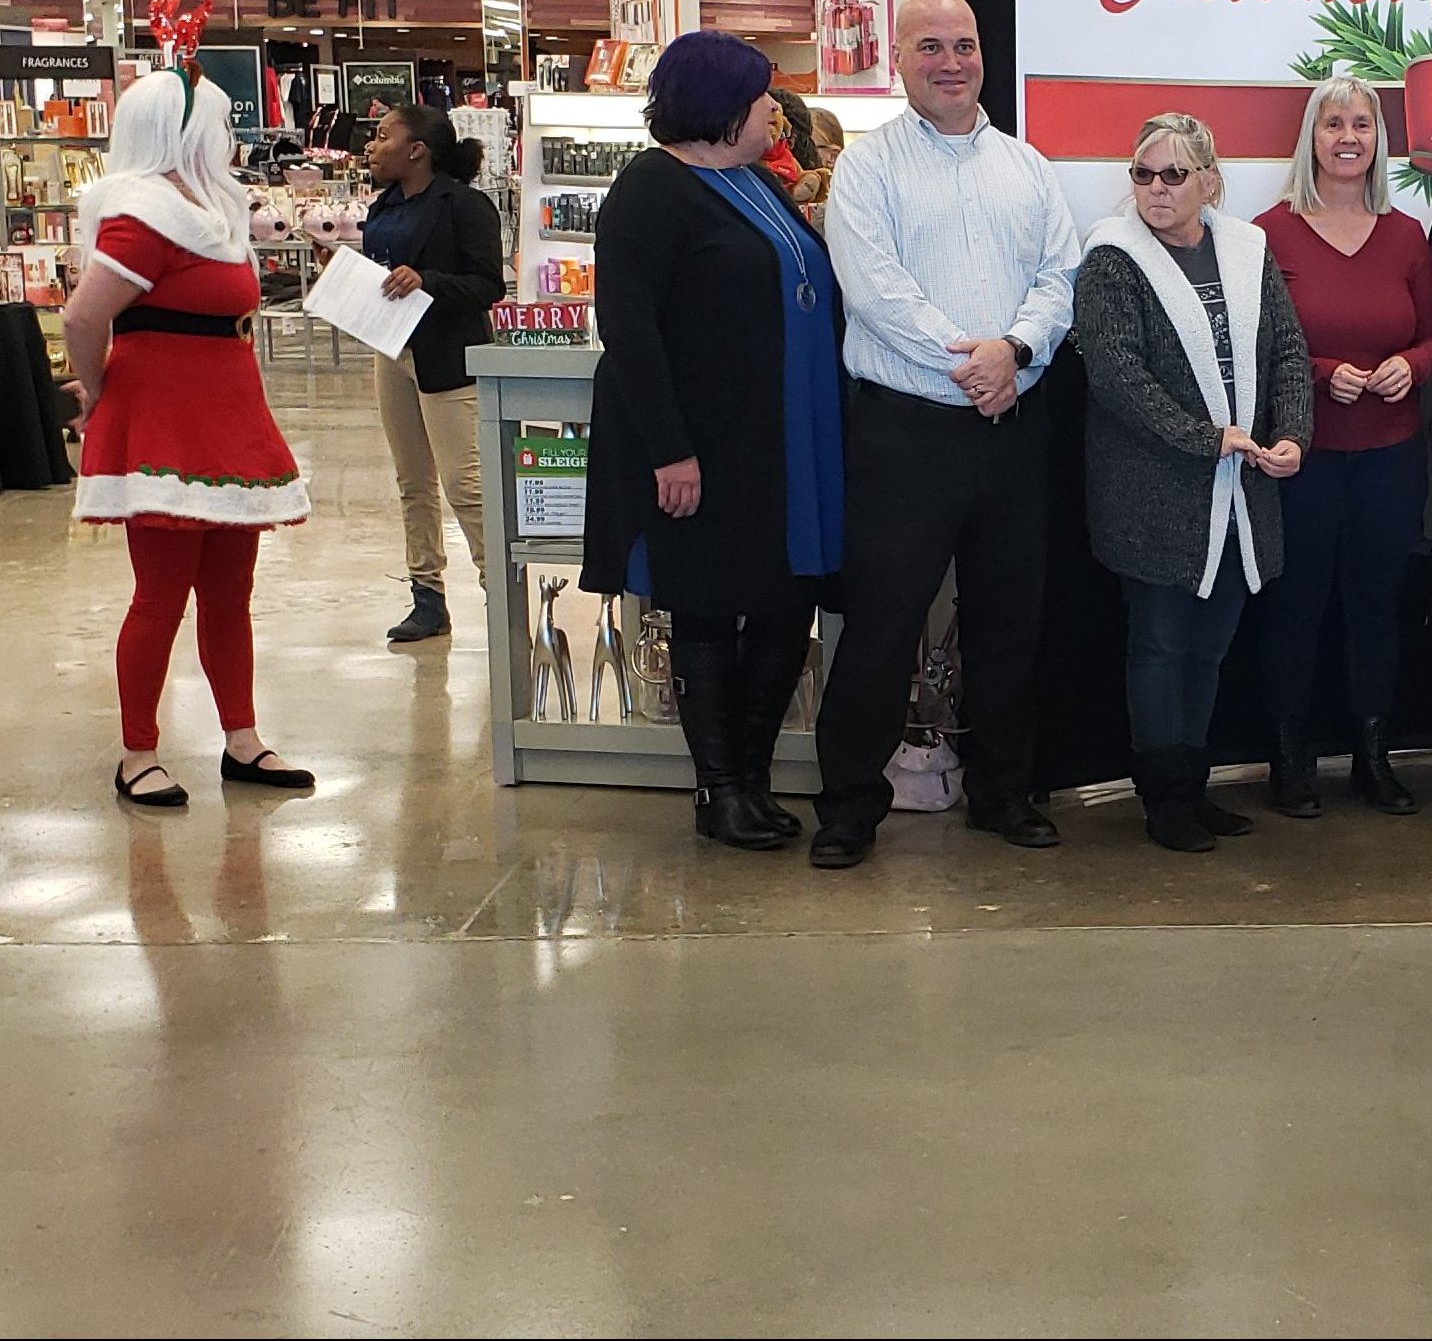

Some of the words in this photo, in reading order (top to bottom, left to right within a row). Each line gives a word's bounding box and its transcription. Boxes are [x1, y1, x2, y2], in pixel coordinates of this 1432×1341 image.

[22, 57, 89, 68] FRAGRANCES
[362, 74, 405, 85] Columbia
[496, 305, 581, 330] MERRY
[510, 330, 572, 346] Christmas
[561, 448, 587, 457] YOUR
